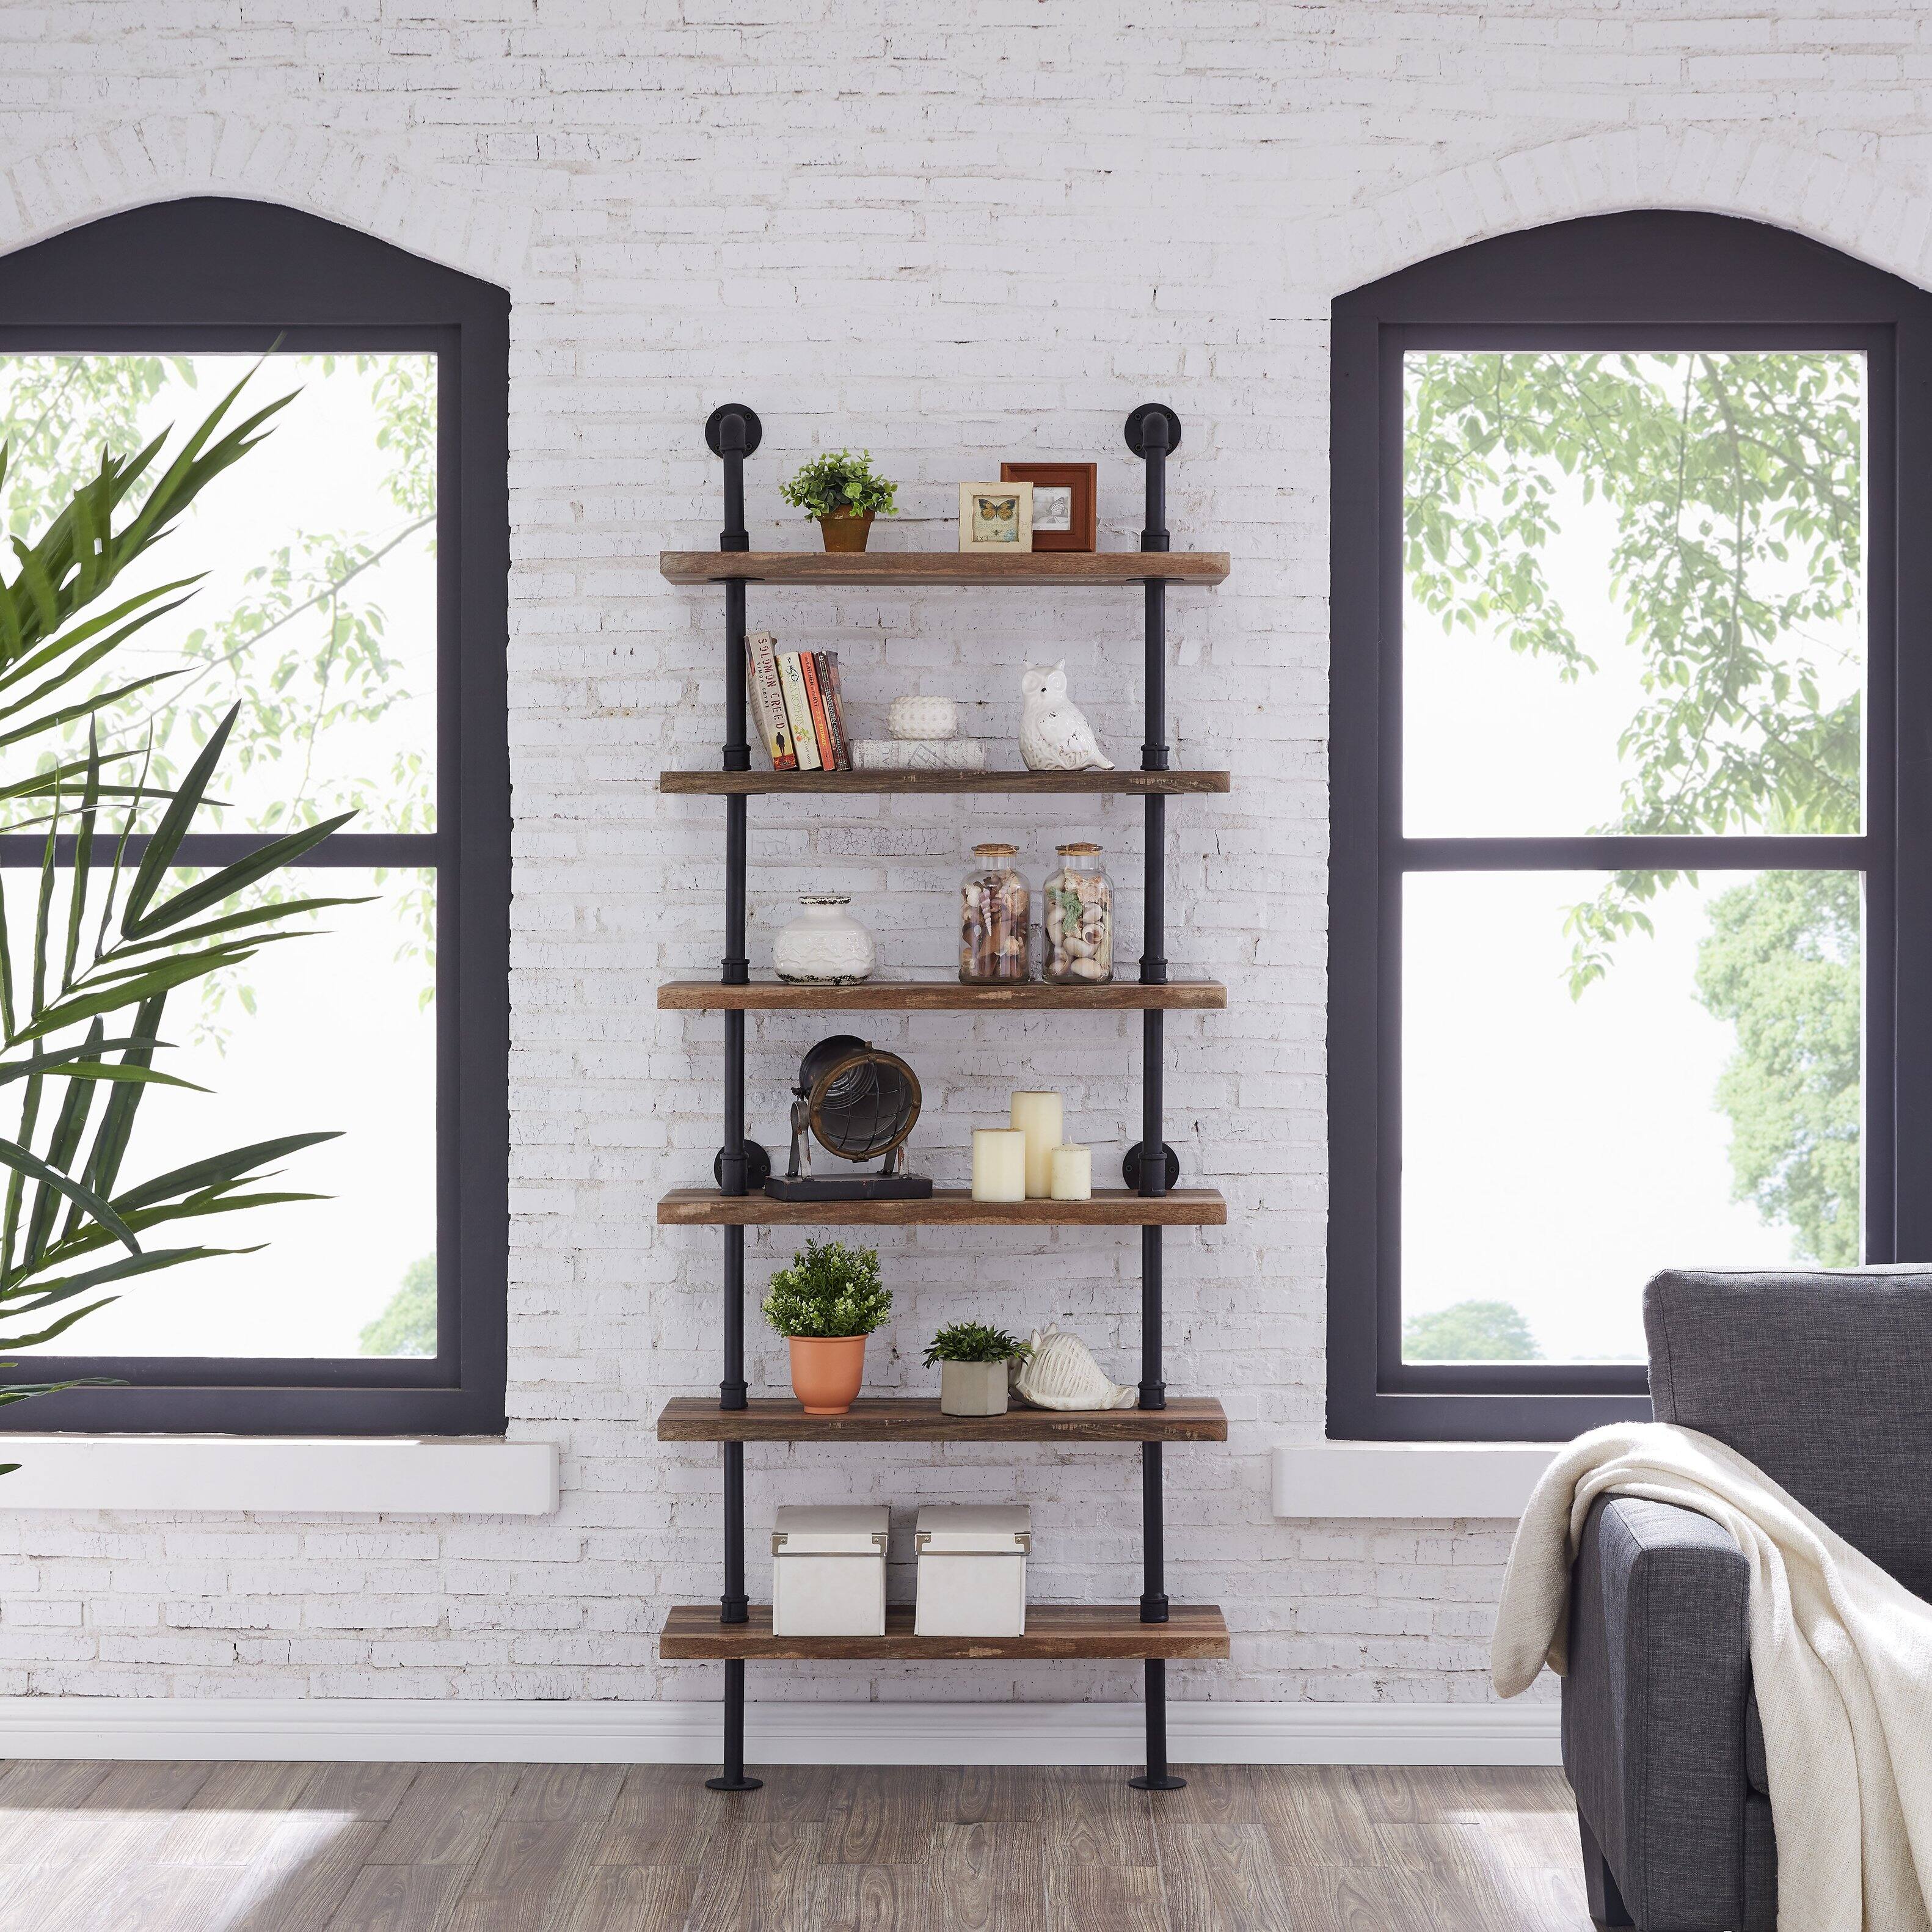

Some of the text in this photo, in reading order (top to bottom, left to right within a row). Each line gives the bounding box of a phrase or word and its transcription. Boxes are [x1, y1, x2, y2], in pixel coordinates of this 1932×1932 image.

[756, 662, 765, 683] SIMON
[758, 638, 785, 729] SOLOMON CREED
[806, 662, 815, 685] CATCHER
[791, 693, 804, 726] ROBERTS
[825, 688, 836, 724] FRANKENSTEIN
